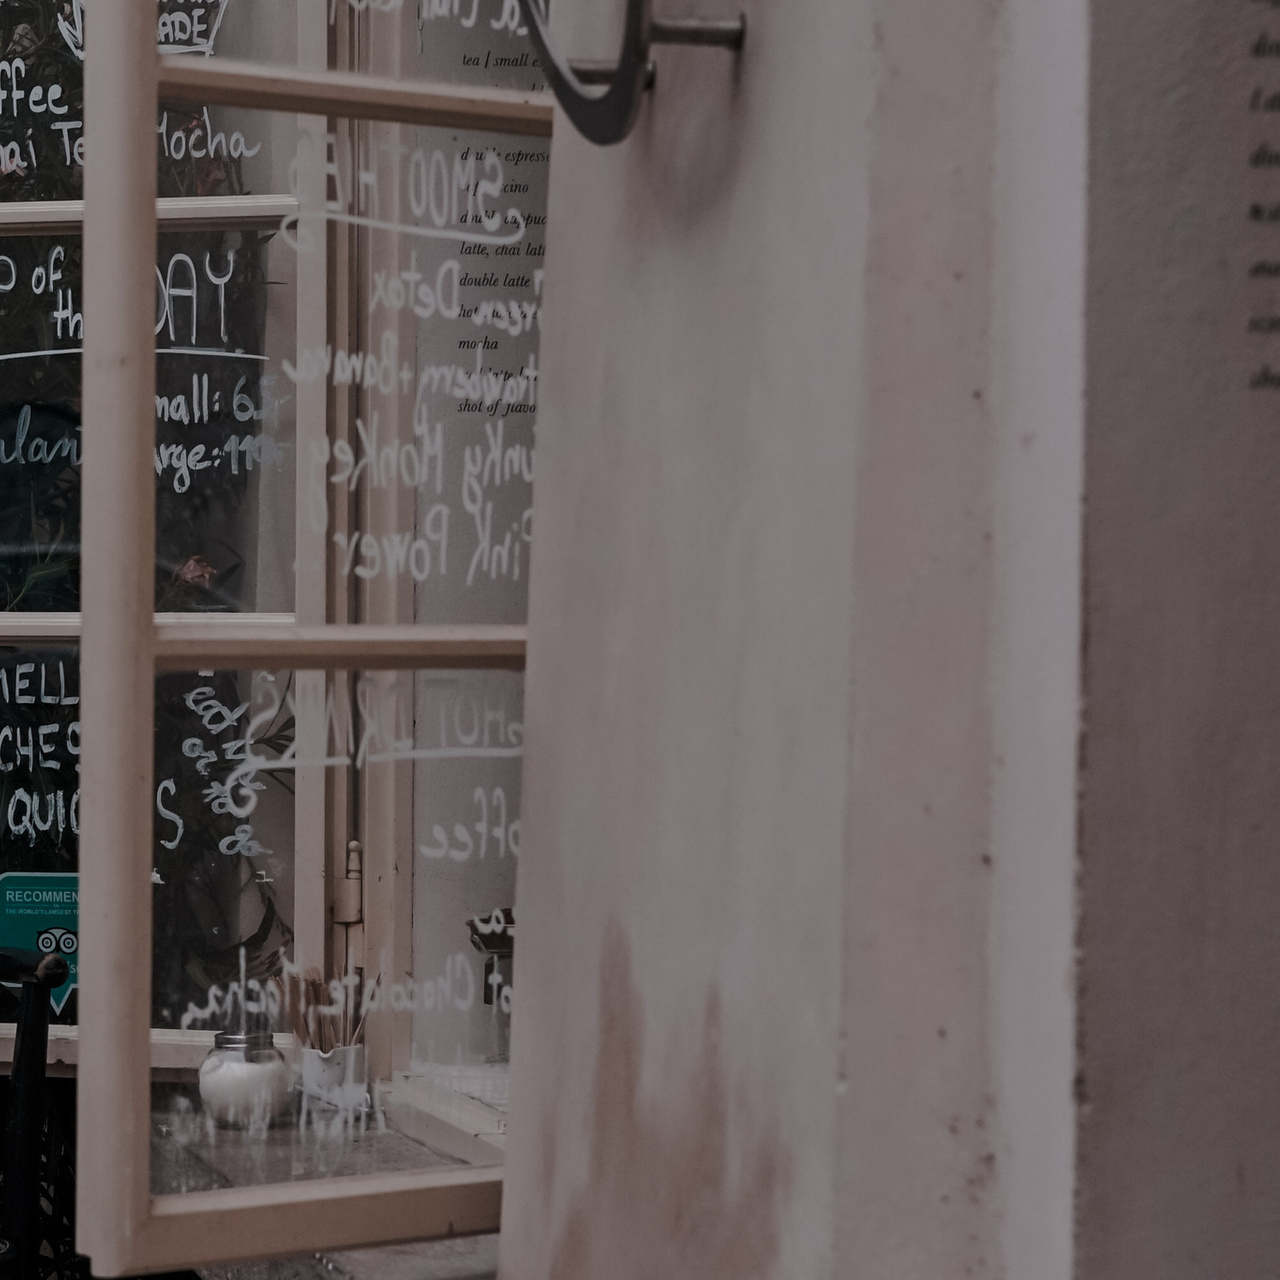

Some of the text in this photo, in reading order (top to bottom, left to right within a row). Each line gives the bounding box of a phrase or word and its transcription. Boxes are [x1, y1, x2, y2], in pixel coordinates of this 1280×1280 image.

[493, 53, 529, 67] small
[51, 120, 85, 168] Te
[460, 241, 490, 259] latte,
[460, 273, 531, 288] double latte
[32, 245, 65, 295] of
[52, 287, 83, 340] th
[458, 399, 483, 413] shot
[487, 399, 502, 417] of
[5, 890, 80, 903] RECOMMEN
